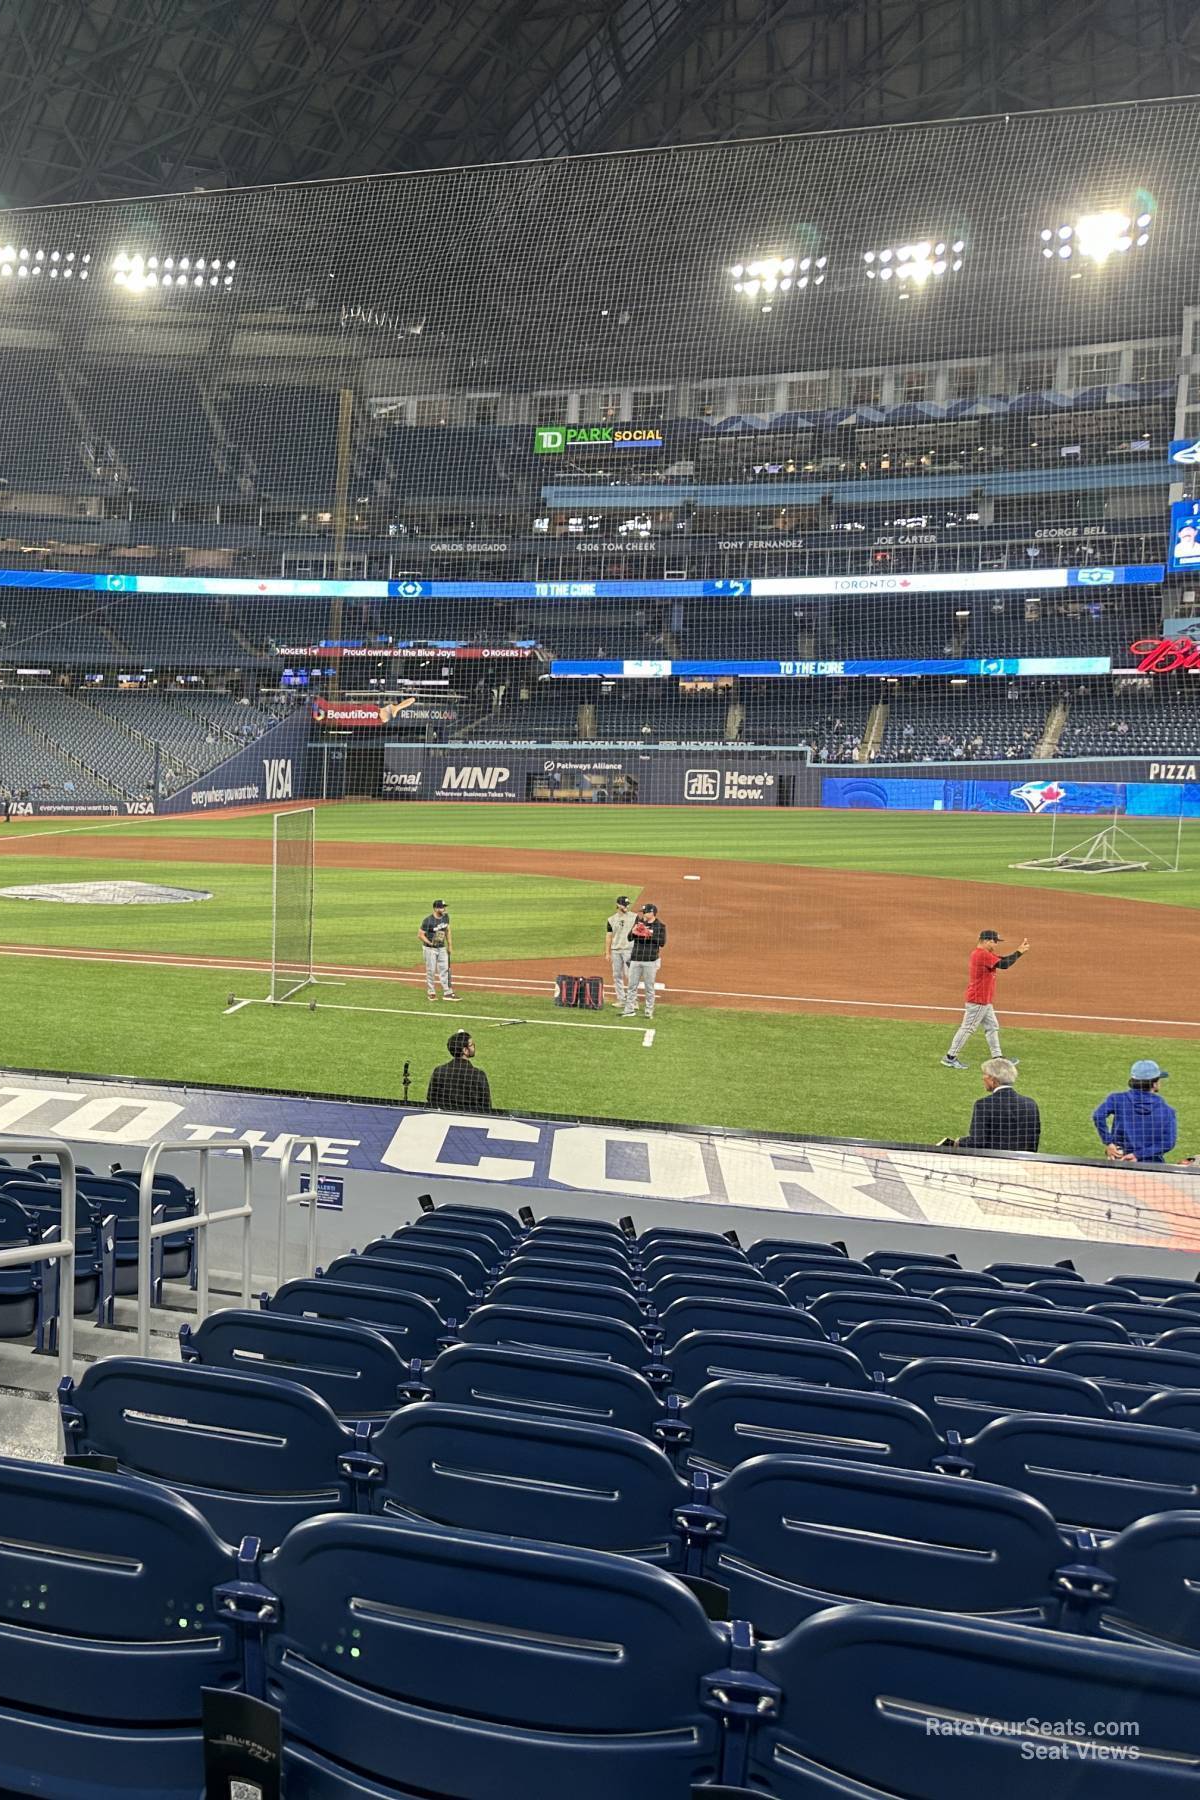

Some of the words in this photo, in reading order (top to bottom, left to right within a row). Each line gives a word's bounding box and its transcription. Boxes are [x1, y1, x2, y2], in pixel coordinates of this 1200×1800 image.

[538, 432, 563, 449] TD
[567, 427, 613, 441] PARK
[614, 430, 663, 441] SOCIAL
[1035, 527, 1079, 538] GEORGE
[1084, 526, 1108, 536] BELL
[576, 543, 599, 551] 4306
[602, 543, 623, 551] TOM
[626, 542, 656, 551] CHEEK
[718, 541, 744, 550] TONY
[748, 539, 804, 549] FERNANDEZ
[874, 536, 894, 546] JOE
[898, 535, 937, 544] CARTER
[466, 544, 507, 552] DELGADO
[535, 583, 549, 596] TO
[550, 583, 570, 596] THE
[570, 583, 596, 597] CORE
[834, 578, 897, 590] TORONTO
[343, 648, 366, 656] Proud
[437, 649, 456, 658] Jays
[780, 662, 793, 674] TO
[795, 662, 816, 674] THE
[818, 662, 845, 674] CORE
[327, 709, 379, 720] BeautiTone
[401, 710, 430, 720] RETHINK
[431, 711, 457, 720] COLOUR
[556, 762, 592, 771] Pathways
[593, 762, 623, 770] Alliance
[1150, 763, 1197, 780] PIZZA
[263, 759, 292, 800] VISA
[441, 766, 510, 789] MNP
[724, 772, 775, 786] Here's
[192, 785, 224, 807] everywhere
[224, 789, 234, 804] you
[234, 786, 247, 800] want
[724, 786, 764, 800] How.
[124, 802, 155, 814] VISA
[380, 1113, 1086, 1239] CORE
